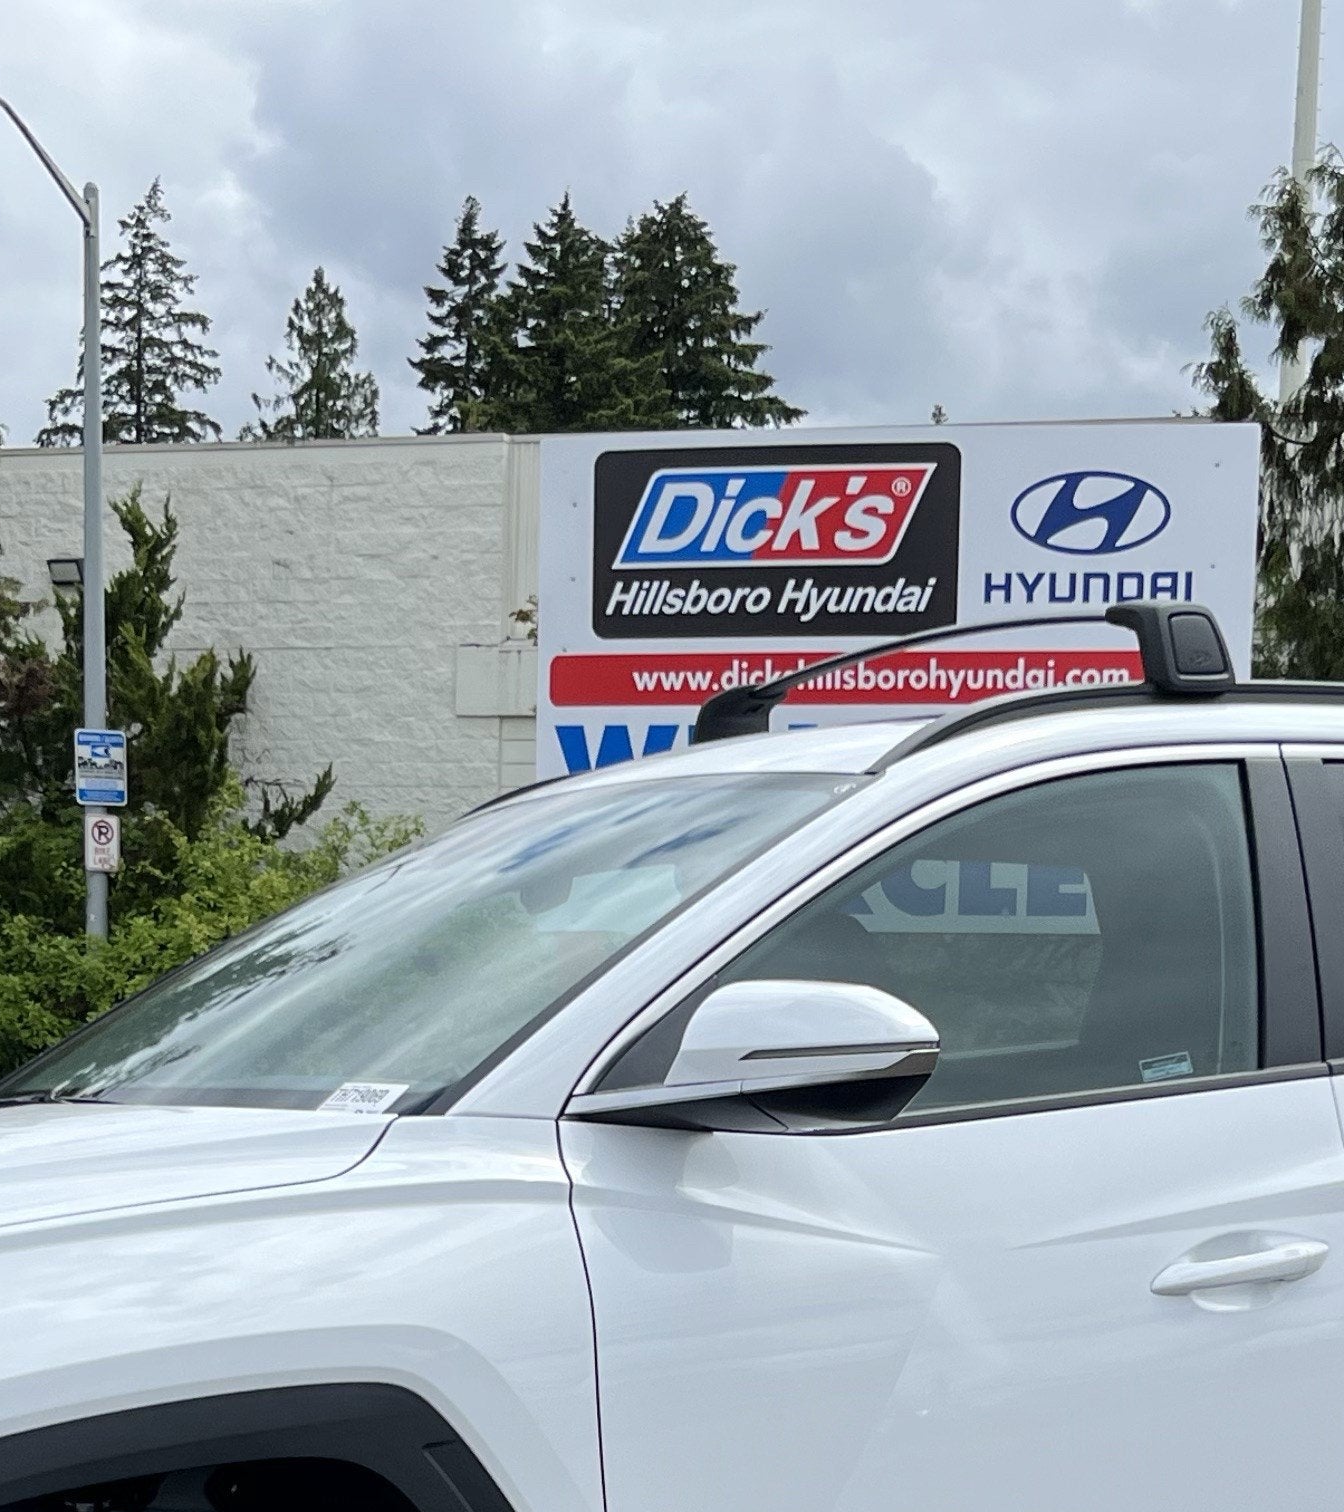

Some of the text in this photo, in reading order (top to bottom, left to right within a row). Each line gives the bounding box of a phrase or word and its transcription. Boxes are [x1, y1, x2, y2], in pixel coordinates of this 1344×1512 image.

[605, 577, 938, 623] Hillsboro Hyundai
[983, 571, 1194, 605] HYUNDAI
[631, 657, 1131, 698] www.dickhllsborohyundai.com
